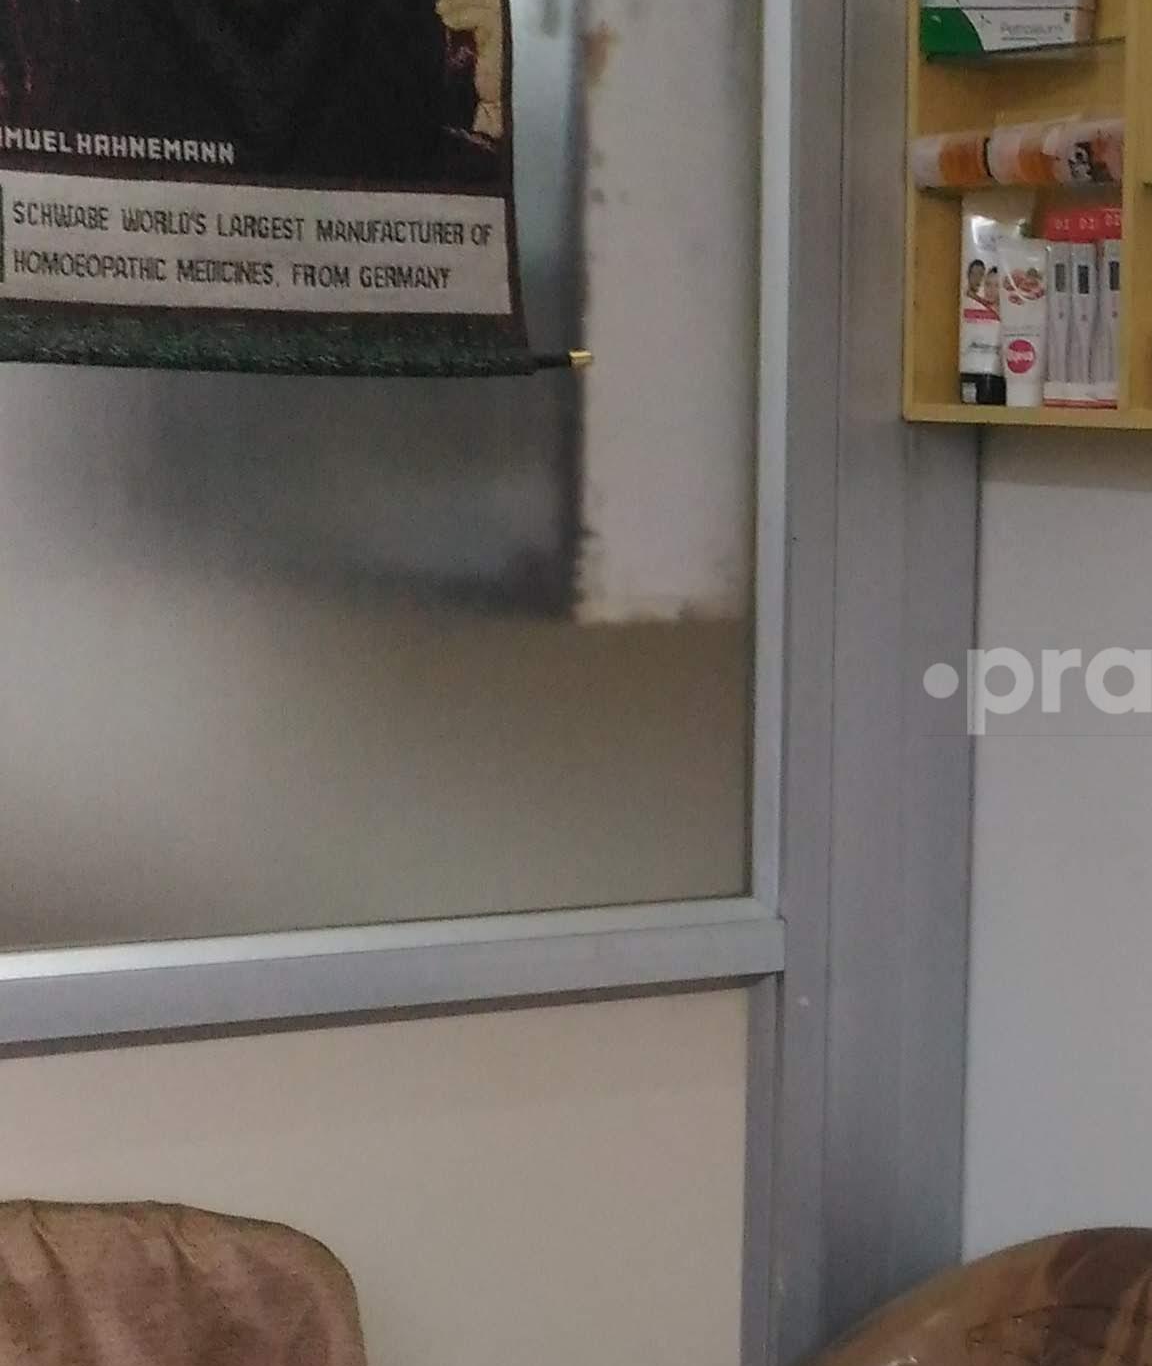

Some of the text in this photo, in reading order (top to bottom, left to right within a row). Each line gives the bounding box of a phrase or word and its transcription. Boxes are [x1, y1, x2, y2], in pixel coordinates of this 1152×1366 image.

[0, 125, 235, 165] MUEL HAHNEMANN
[12, 201, 493, 246] SCHWABE WORLD'S LARGEST MANUFACTURER OF
[13, 248, 168, 282] HOMOEOPATHIC
[292, 262, 350, 289] FROM
[359, 265, 451, 290] GERMANY
